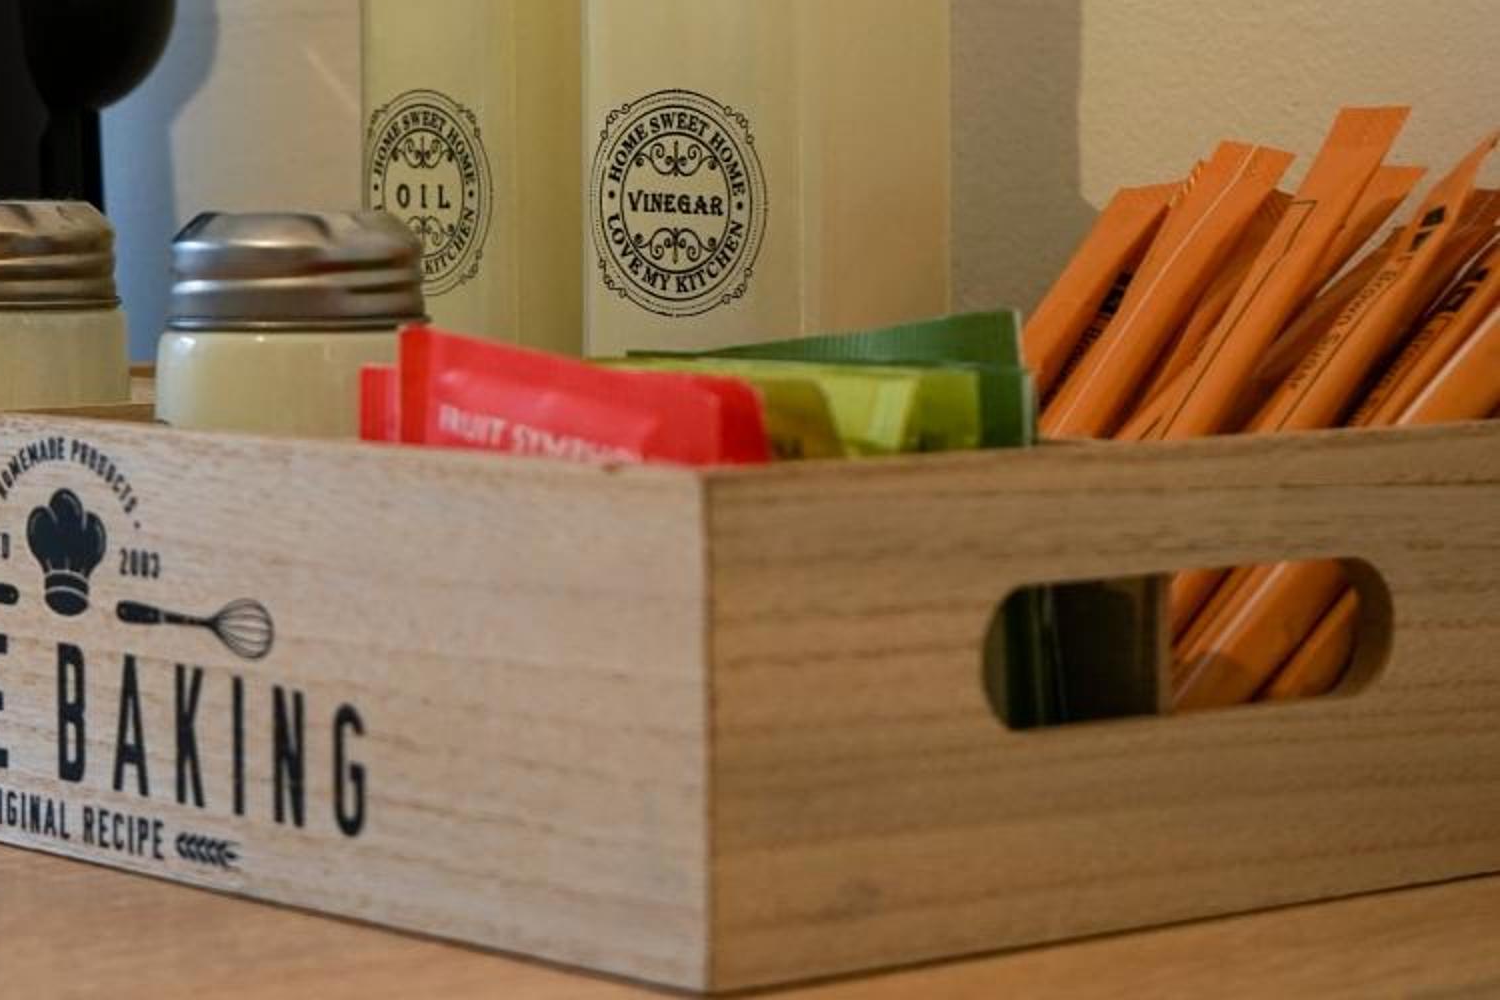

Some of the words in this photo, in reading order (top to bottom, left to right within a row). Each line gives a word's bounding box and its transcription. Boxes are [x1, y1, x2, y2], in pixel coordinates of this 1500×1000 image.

[373, 120, 402, 176] HOME
[402, 110, 447, 134] SWEET
[447, 128, 477, 186] HOME
[608, 123, 648, 183] HOME
[649, 111, 710, 138] SWEET
[708, 131, 746, 197] HOME
[396, 182, 451, 209] OIL
[627, 189, 724, 217] VINEGAR
[424, 206, 476, 275] KITCHEN
[607, 213, 641, 276] LOVE
[641, 268, 671, 292] MY
[675, 220, 744, 294] KITCHEN
[70, 439, 139, 514] PRODUCTS
[119, 547, 162, 580] 2003
[57, 642, 367, 838] BAKING
[83, 804, 165, 860] RECIPE
